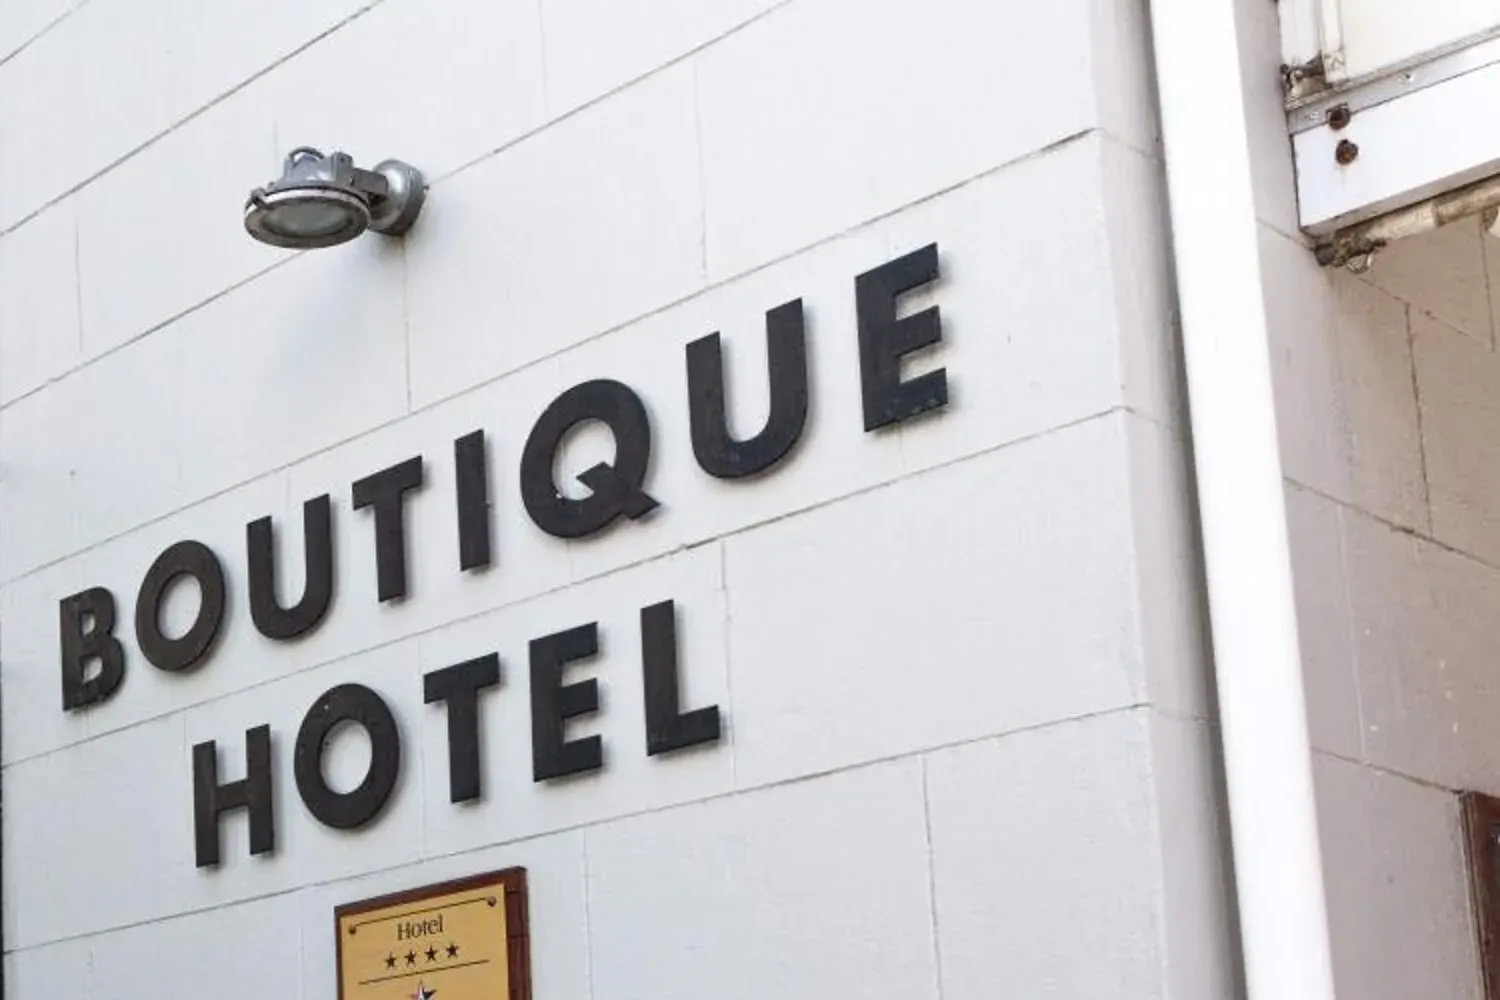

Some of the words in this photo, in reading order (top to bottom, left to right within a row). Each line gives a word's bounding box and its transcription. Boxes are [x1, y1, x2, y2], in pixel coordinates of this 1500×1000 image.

[60, 243, 950, 711] BOUTIQUE
[192, 599, 721, 868] HOTEL
[397, 912, 443, 941] Hotel
